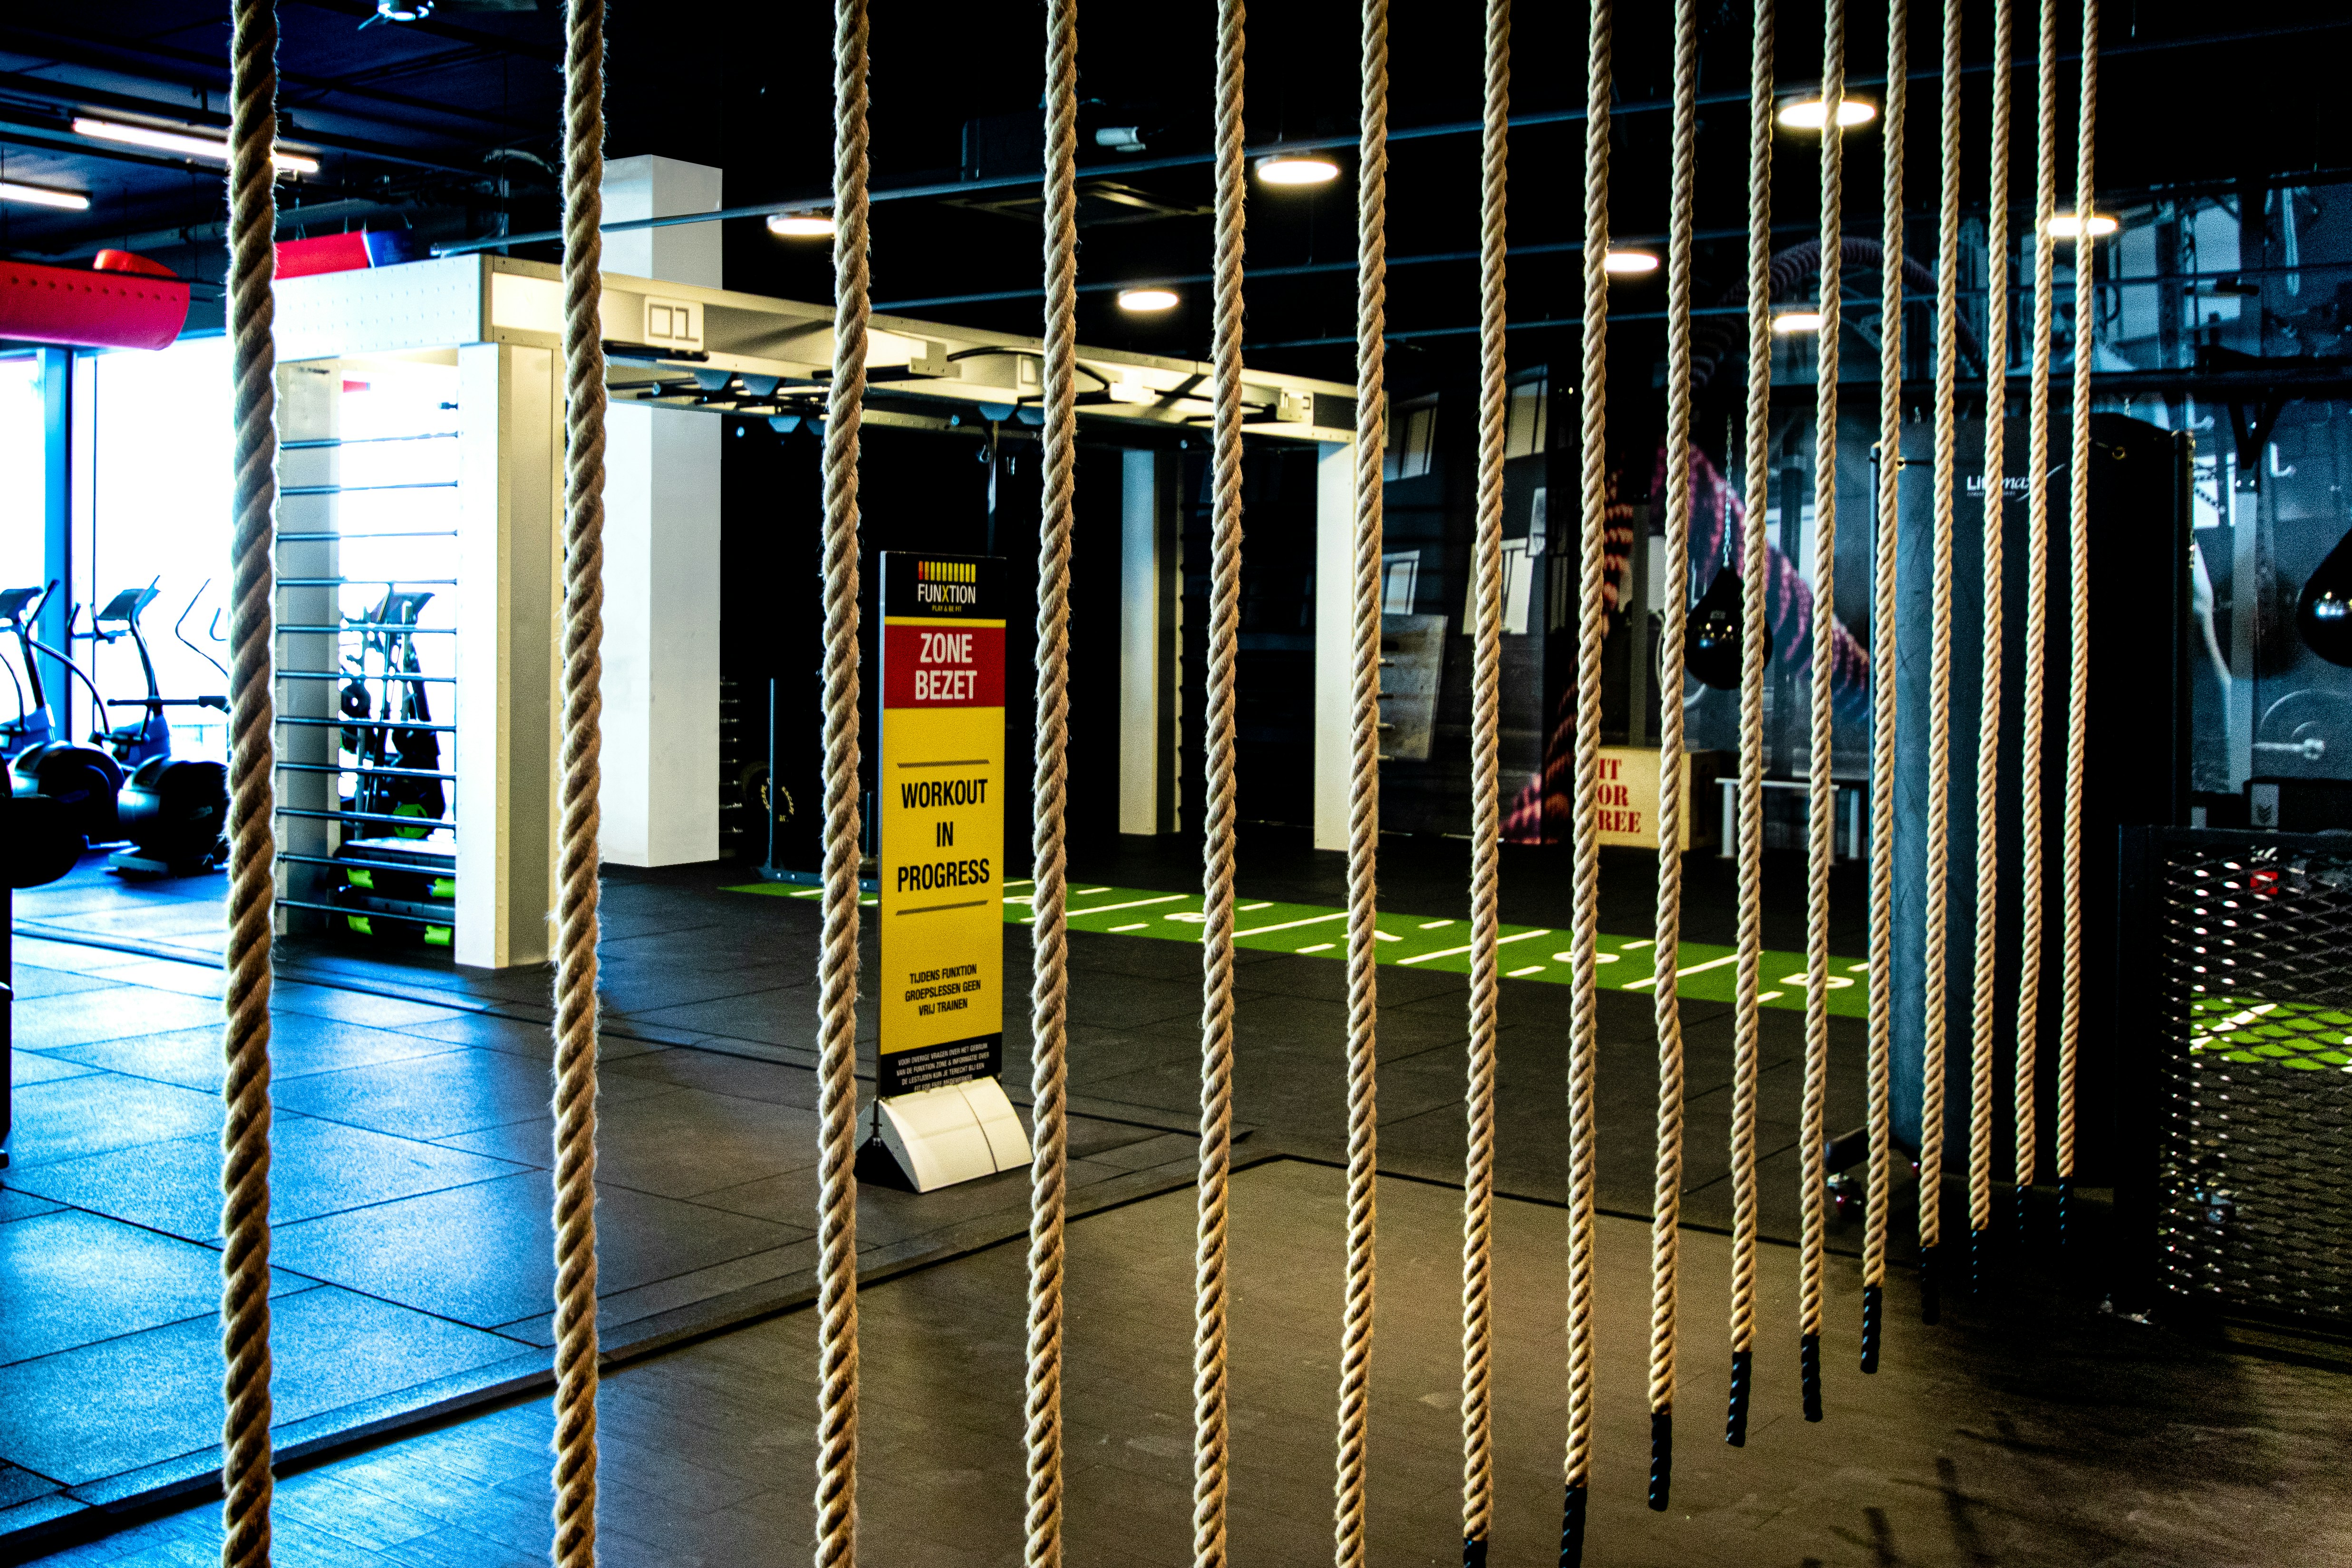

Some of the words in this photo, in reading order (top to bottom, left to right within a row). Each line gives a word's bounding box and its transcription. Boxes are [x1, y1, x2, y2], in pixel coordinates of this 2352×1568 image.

[918, 583, 976, 603] FUNXTION
[920, 633, 973, 663] ZONE
[915, 670, 978, 700] BEZET
[1599, 758, 1622, 780] IT
[901, 779, 988, 808] WORKOUT
[1597, 784, 1628, 806] OR
[1598, 809, 1641, 833] REE
[937, 821, 954, 847] IN
[898, 858, 990, 892] PROGRESS
[909, 969, 940, 984] TIJDENS
[941, 963, 978, 979] FUNXTION
[905, 983, 961, 1002] GROEPSLESSEN
[963, 979, 981, 993] GEEN
[919, 1004, 935, 1016] VRIJ
[937, 997, 968, 1013] TRAINEN
